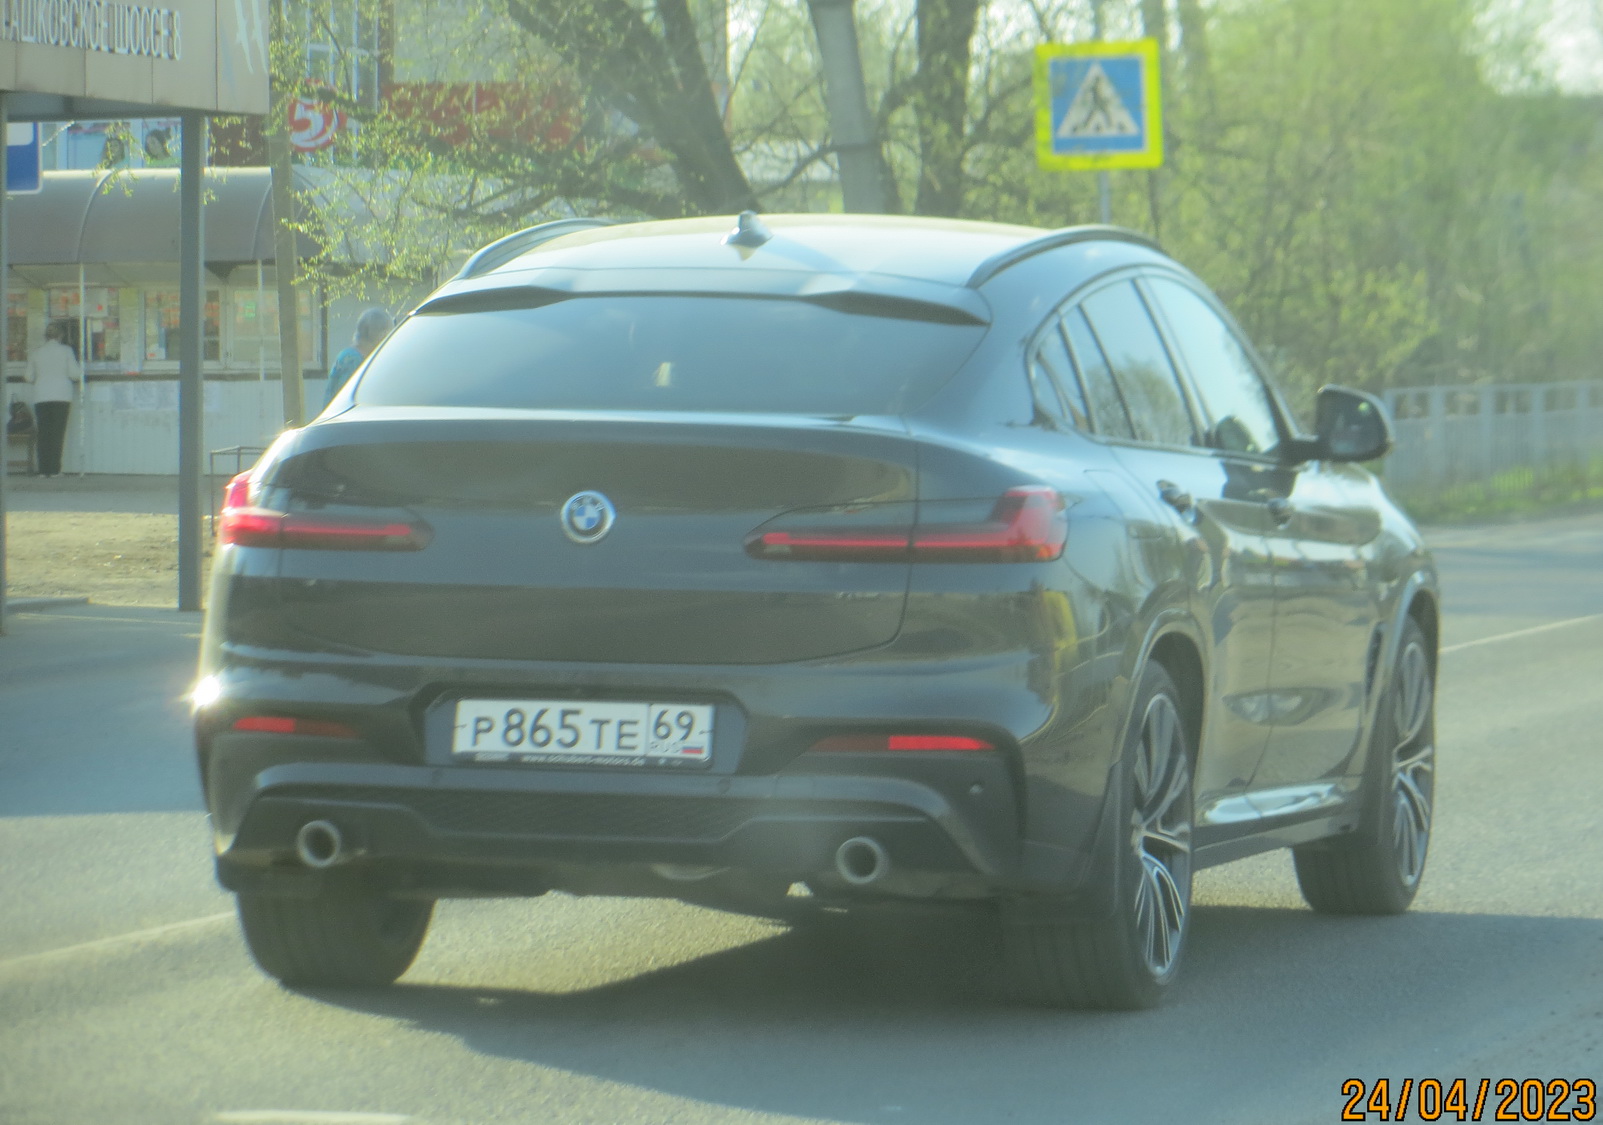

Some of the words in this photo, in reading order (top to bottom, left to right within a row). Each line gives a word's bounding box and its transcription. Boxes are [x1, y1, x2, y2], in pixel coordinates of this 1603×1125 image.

[114, 3, 171, 59] ШОССЕ
[173, 9, 182, 61] 8
[652, 708, 696, 742] 69
